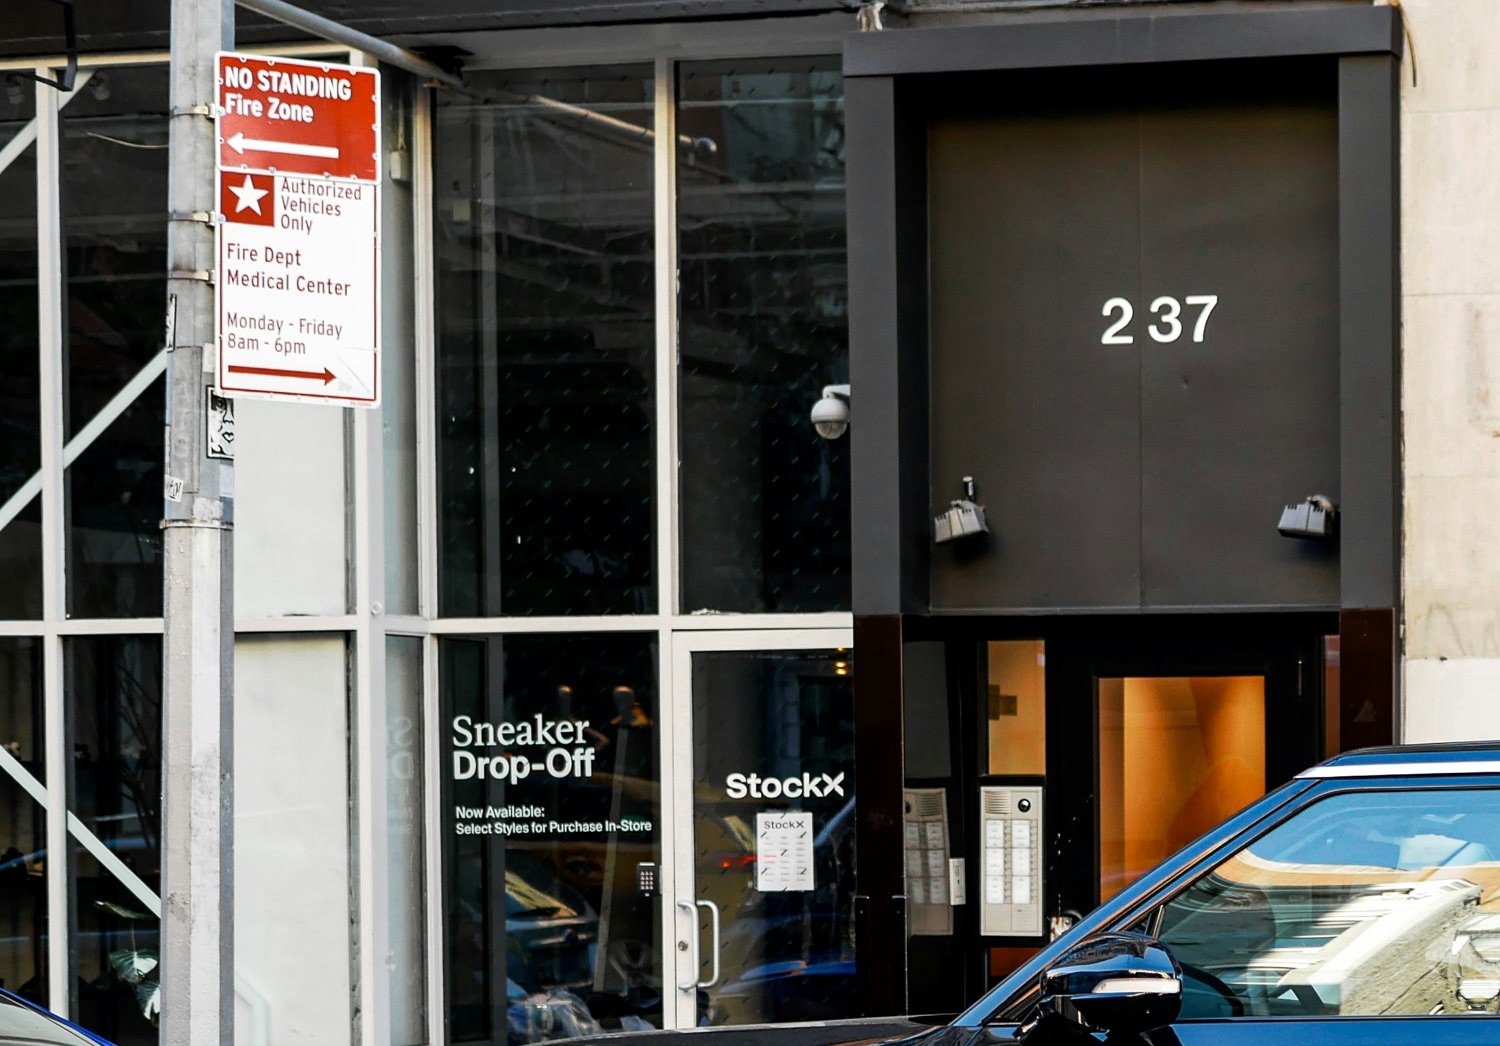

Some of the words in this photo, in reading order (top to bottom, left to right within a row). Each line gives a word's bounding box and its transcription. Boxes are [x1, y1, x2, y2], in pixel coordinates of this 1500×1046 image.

[225, 65, 254, 90] NO
[257, 69, 352, 101] STANDING
[225, 92, 264, 118] Fire
[267, 97, 314, 123] Zone
[281, 176, 362, 201] Authorized
[281, 195, 342, 217] Vehicles
[280, 213, 313, 235] Only
[227, 242, 258, 262] Fire
[264, 246, 302, 267] Dept
[227, 268, 290, 291] Medical
[296, 275, 351, 297] Center
[227, 311, 284, 334] Monday
[299, 318, 343, 340] Friday
[227, 332, 260, 352] 8am
[274, 337, 306, 356] 6pm
[452, 713, 590, 747] Sneaker
[453, 747, 595, 785] Drop-Off
[726, 772, 845, 799] StockX
[455, 806, 483, 819] Now
[485, 805, 545, 819] Available:
[455, 822, 492, 835] Select
[494, 821, 530, 836] Styles
[531, 821, 547, 834] for
[549, 820, 603, 834] Purchase
[605, 819, 652, 833] In-Store
[764, 820, 805, 830] StockX
